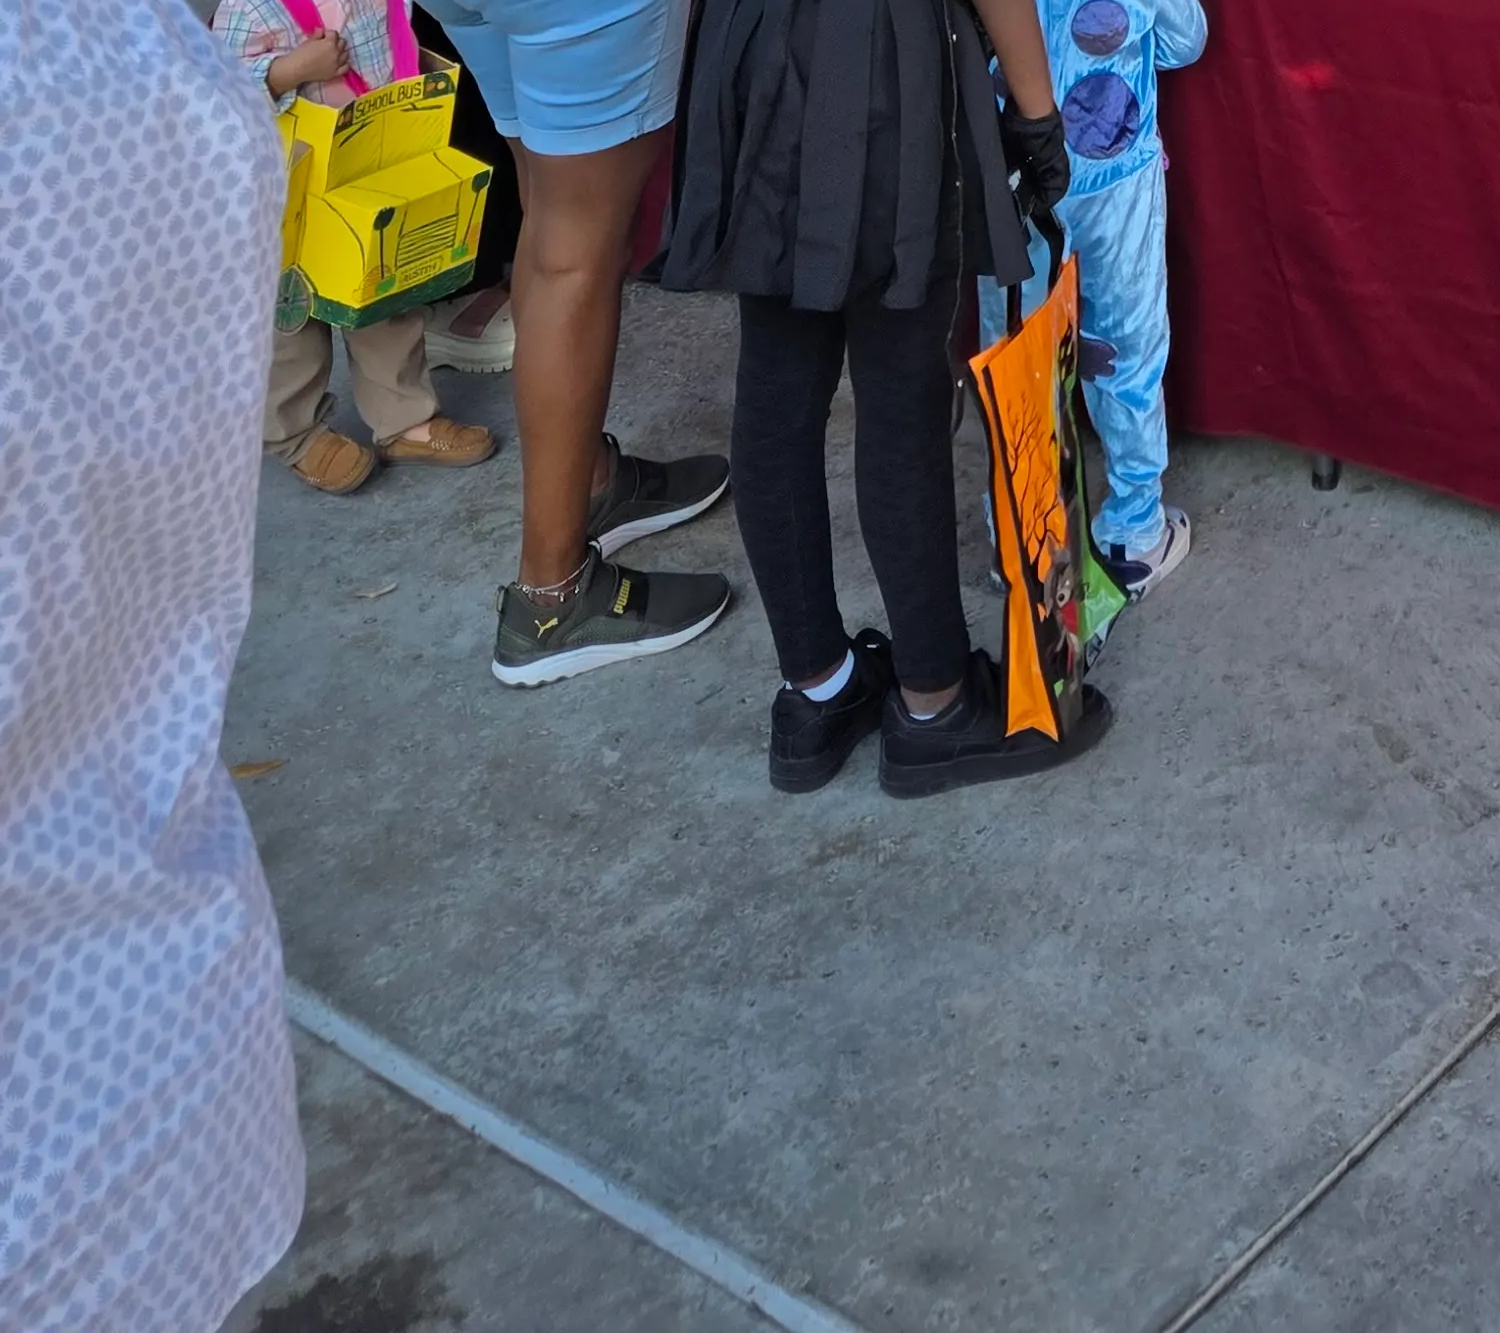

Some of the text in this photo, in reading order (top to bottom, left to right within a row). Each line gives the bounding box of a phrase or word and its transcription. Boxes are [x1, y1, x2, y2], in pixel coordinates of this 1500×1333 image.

[355, 82, 421, 119] SCHOOL BUS
[613, 577, 631, 615] PUMA
